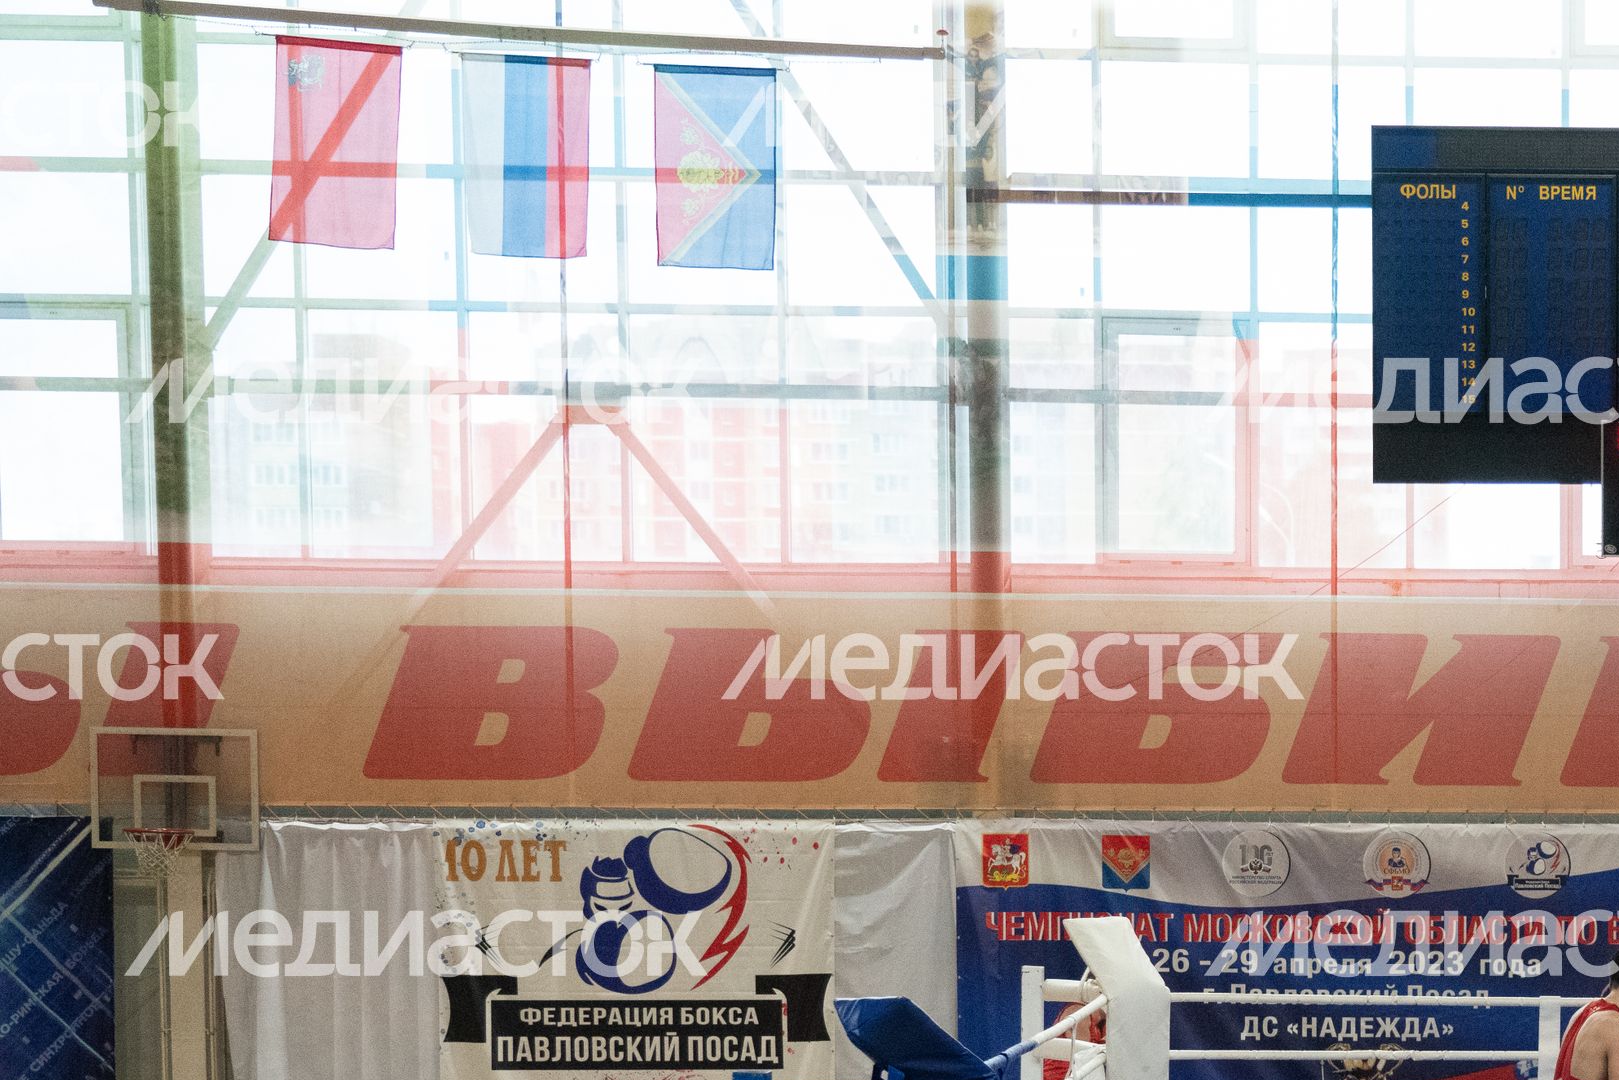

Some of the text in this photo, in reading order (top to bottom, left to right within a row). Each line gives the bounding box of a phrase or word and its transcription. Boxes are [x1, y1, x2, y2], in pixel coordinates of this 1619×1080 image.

[1400, 184, 1456, 199] ФОЛЫ
[1539, 186, 1596, 200] ВРЕМЯ
[1461, 202, 1469, 210] 4
[1462, 220, 1469, 228] 5
[1462, 237, 1469, 246] 6
[1462, 255, 1469, 263] 7
[1462, 273, 1469, 281] 8
[1462, 290, 1469, 298] 9
[1462, 308, 1475, 316] 10
[1462, 326, 1475, 334] 11
[1462, 343, 1475, 351] 12
[1462, 378, 1476, 386] 14
[1462, 395, 1475, 404] 15
[444, 839, 567, 882] 10 ЛЕТ
[1183, 908, 1391, 945] МОСКОВСКОЙ
[1404, 915, 1548, 946] ОБЛАСТИ
[1555, 915, 1598, 945] ПО
[1151, 948, 1541, 978] 26 29 апреля 2023 года
[519, 1007, 759, 1028] ФЕДЕРАЦИЯ БОКСА
[1241, 1016, 1454, 1042] ДС «НАДЕЖДА»
[497, 1032, 779, 1065] ПАВЛОВСКИЙ ПОСАД
